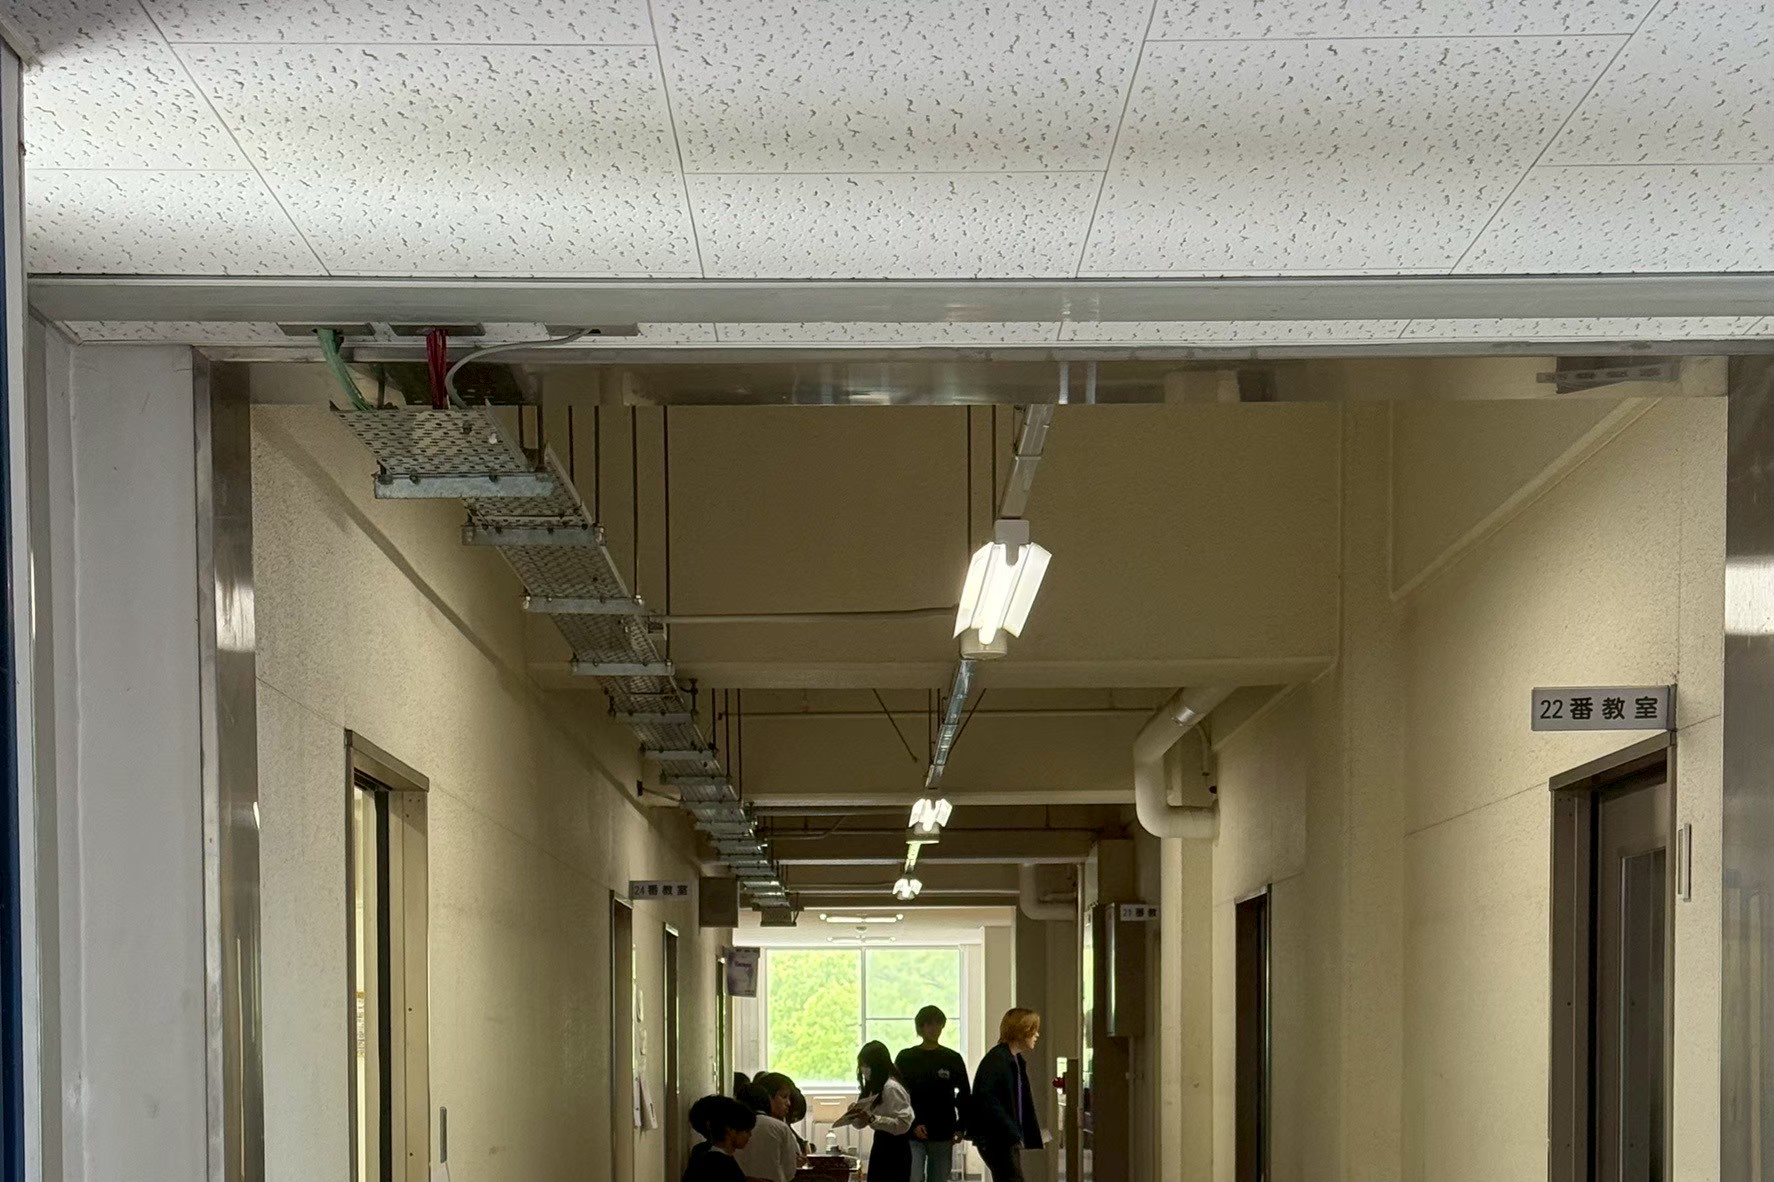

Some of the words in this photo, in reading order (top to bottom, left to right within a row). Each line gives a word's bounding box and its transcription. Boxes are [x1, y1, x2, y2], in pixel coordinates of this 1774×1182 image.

[1540, 696, 1657, 720] 22番教室
[634, 884, 688, 896] 24番教室
